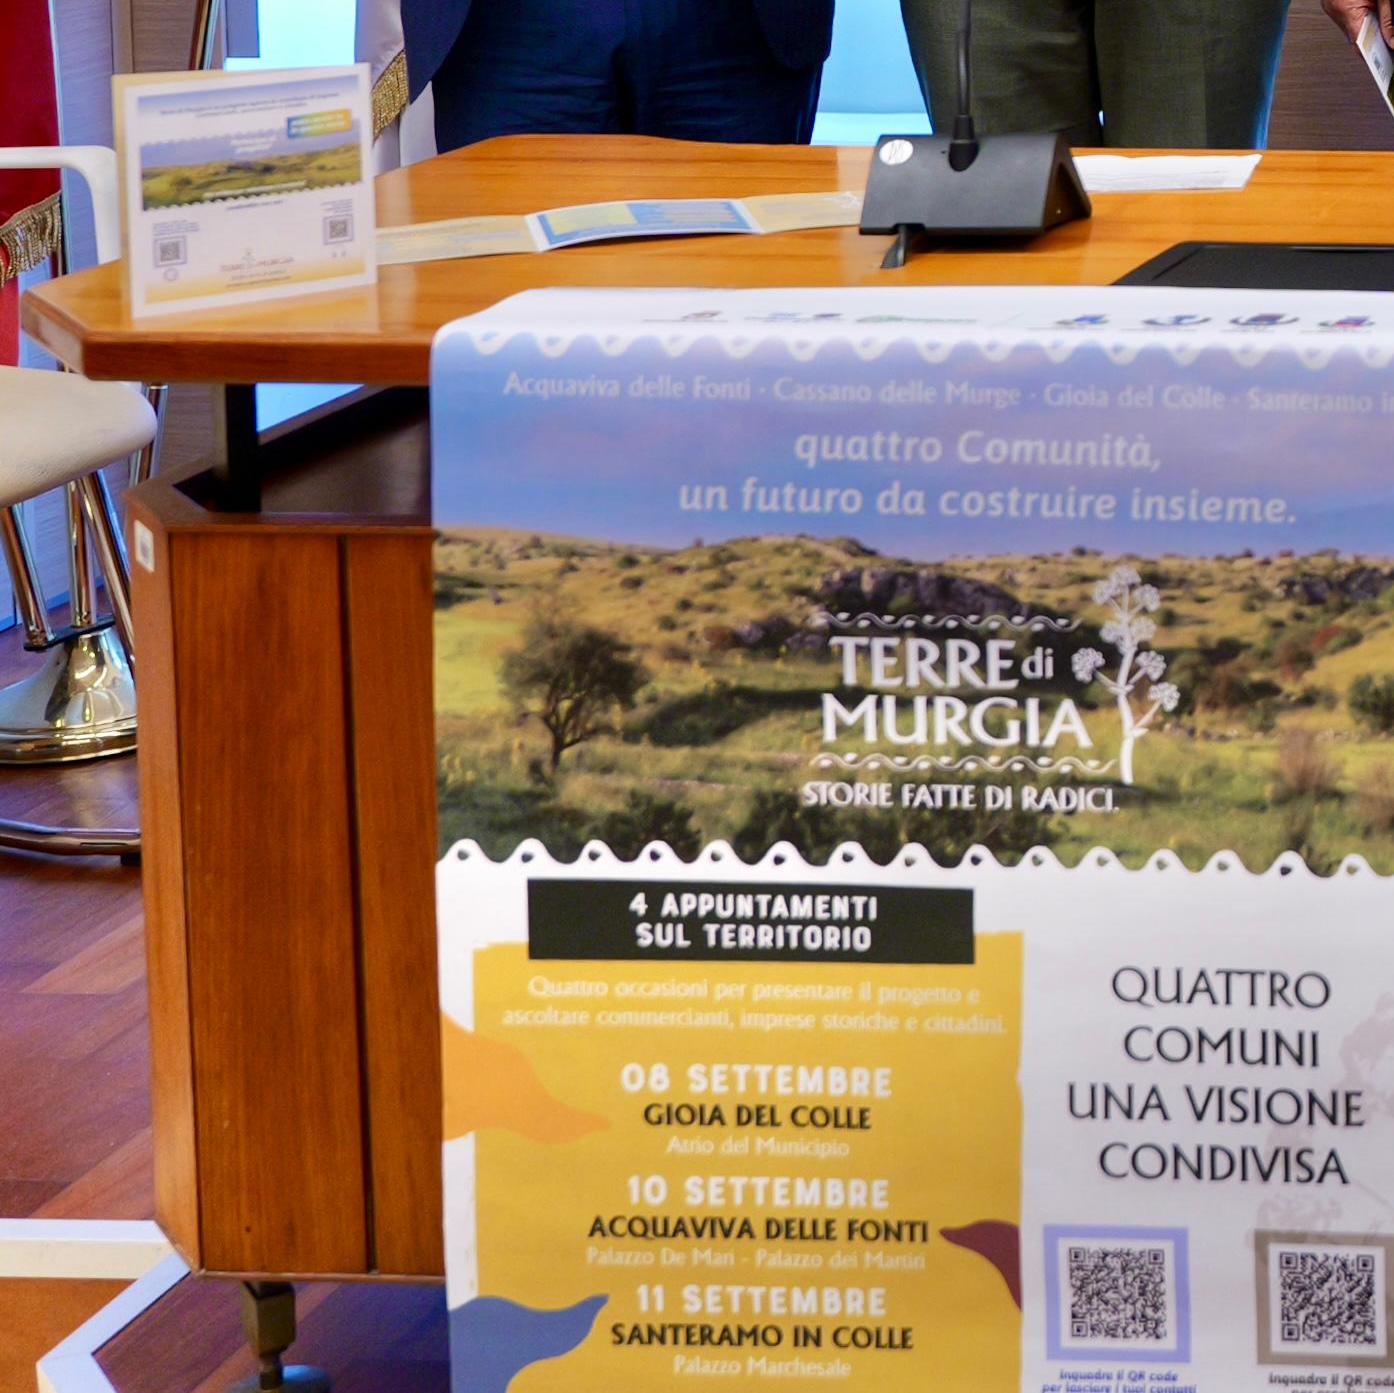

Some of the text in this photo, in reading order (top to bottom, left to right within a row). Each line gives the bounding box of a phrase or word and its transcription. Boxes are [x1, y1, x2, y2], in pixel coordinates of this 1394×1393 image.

[503, 371, 620, 398] Acquaviva
[629, 374, 685, 397] delle
[693, 376, 751, 400] Fonti
[774, 377, 871, 402] Cassano
[881, 379, 937, 403] delle
[945, 381, 1021, 408] Murge
[1044, 383, 1108, 406] Gioia
[1118, 384, 1154, 407] del
[1162, 385, 1225, 408] Colle
[1248, 387, 1370, 413] Santeramo
[794, 429, 1160, 471] quattro Comunità,
[680, 477, 1296, 524] un futuro da costruire insieme.
[829, 635, 1053, 689] TERRE di
[822, 692, 1093, 749] MURGIA
[802, 780, 894, 807] STORIE
[901, 783, 976, 809] FATTE
[985, 785, 1012, 809] DI
[630, 892, 877, 921] 4 APPUNTAMENTI
[636, 923, 872, 952] SUL TERRITORIO
[527, 976, 979, 1008] Quattro occasioni per presentare il progetto e
[1111, 966, 1330, 1008] QUATTRO
[503, 1005, 1007, 1035] ascoltare commercianti, imprese storiche e cittadini.
[1124, 1026, 1320, 1067] COMUNI
[621, 1063, 892, 1097] 08 SETTEMBRE
[644, 1103, 872, 1131] GIOIA DEL COLLE
[1068, 1082, 1365, 1127] UNA VISIONE
[664, 1136, 849, 1159] Atrio del Municipio
[1100, 1143, 1350, 1184] CONDIVISA
[628, 1175, 889, 1209] 10 SETTEMBRE
[588, 1215, 928, 1243] ACQUAVIVA DELLE FONTI
[586, 1246, 925, 1271] Palazzo De Mari Palazzo dei Martiri
[636, 1284, 886, 1316] 11 SETTEMBRE
[611, 1323, 913, 1349] SANTERAMO IN COLLE
[674, 1356, 851, 1376] Palazzo Marchesale
